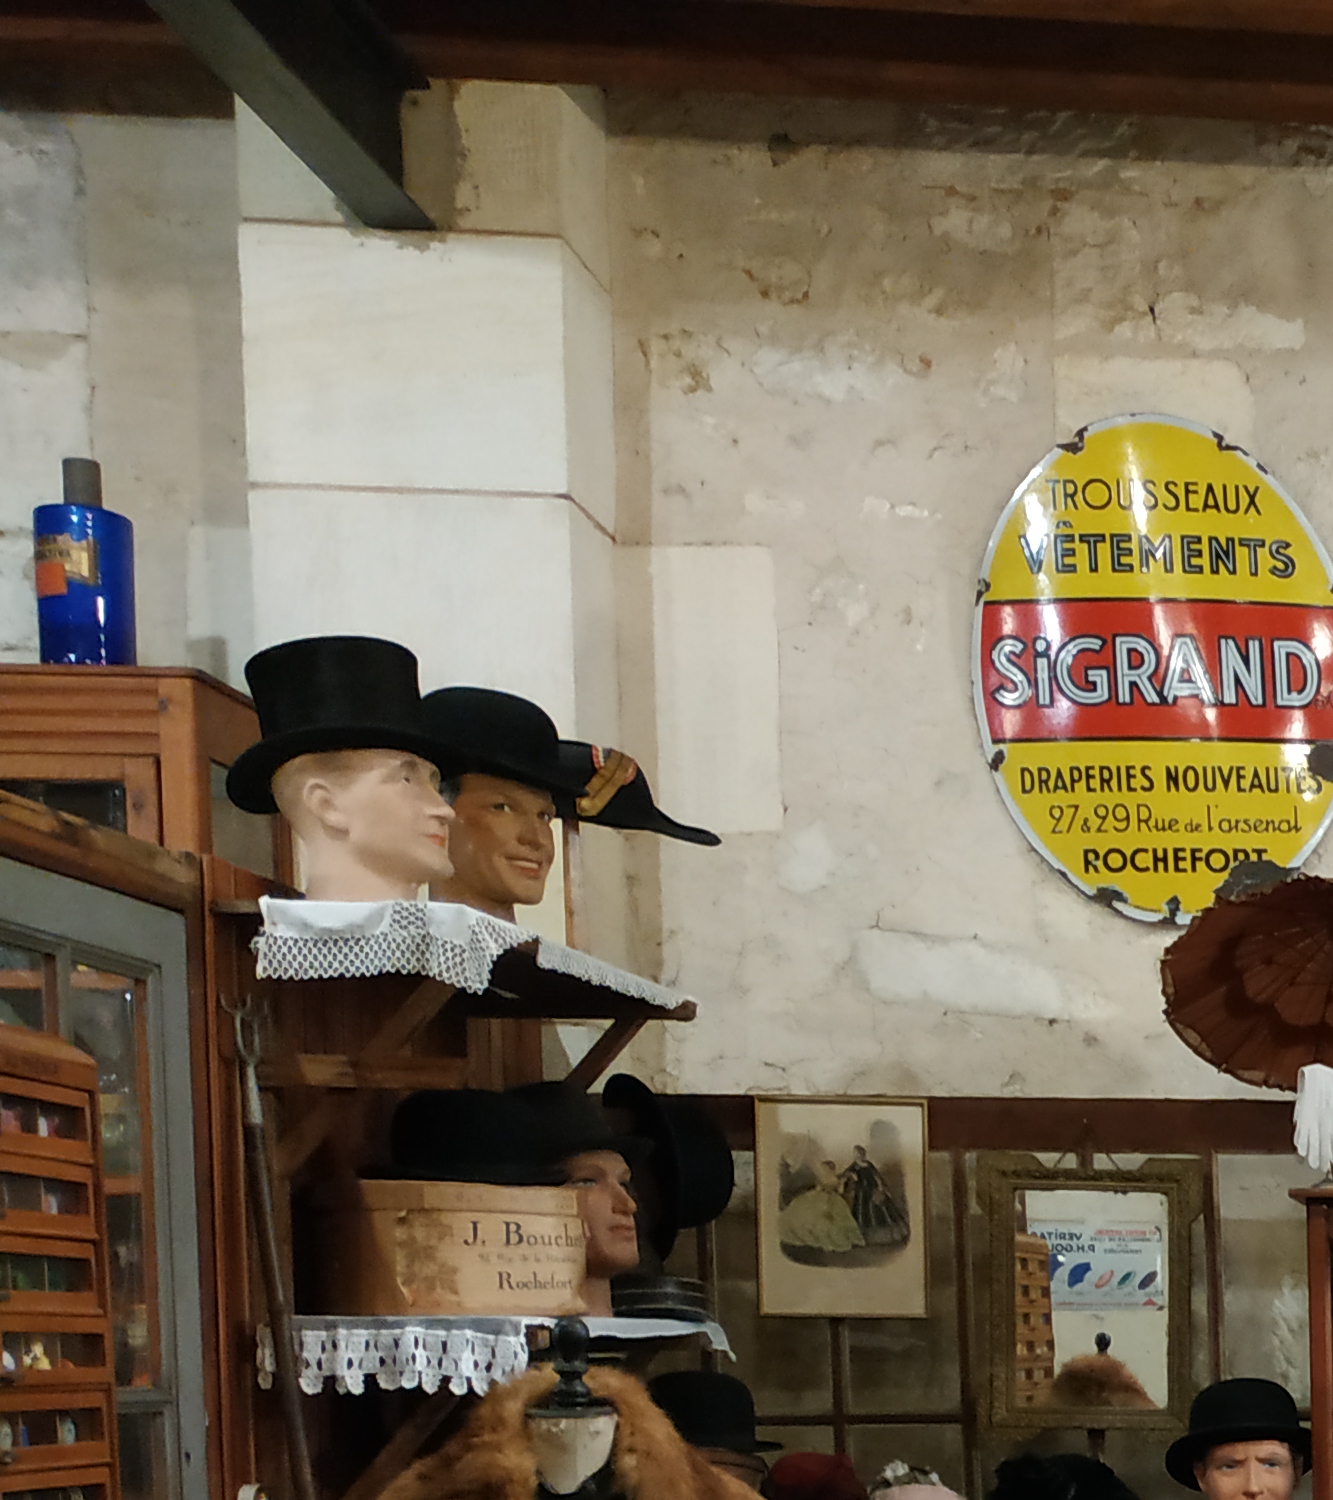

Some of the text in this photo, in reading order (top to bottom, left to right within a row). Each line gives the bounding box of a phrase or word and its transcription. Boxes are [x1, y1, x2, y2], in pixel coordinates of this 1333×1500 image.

[1046, 477, 1262, 517] TROUSSEAUX
[1018, 521, 1297, 578] VÊTEMENTS
[1020, 764, 1155, 795] DRAPERIES
[1136, 803, 1180, 834] Rue
[1184, 818, 1203, 834] de
